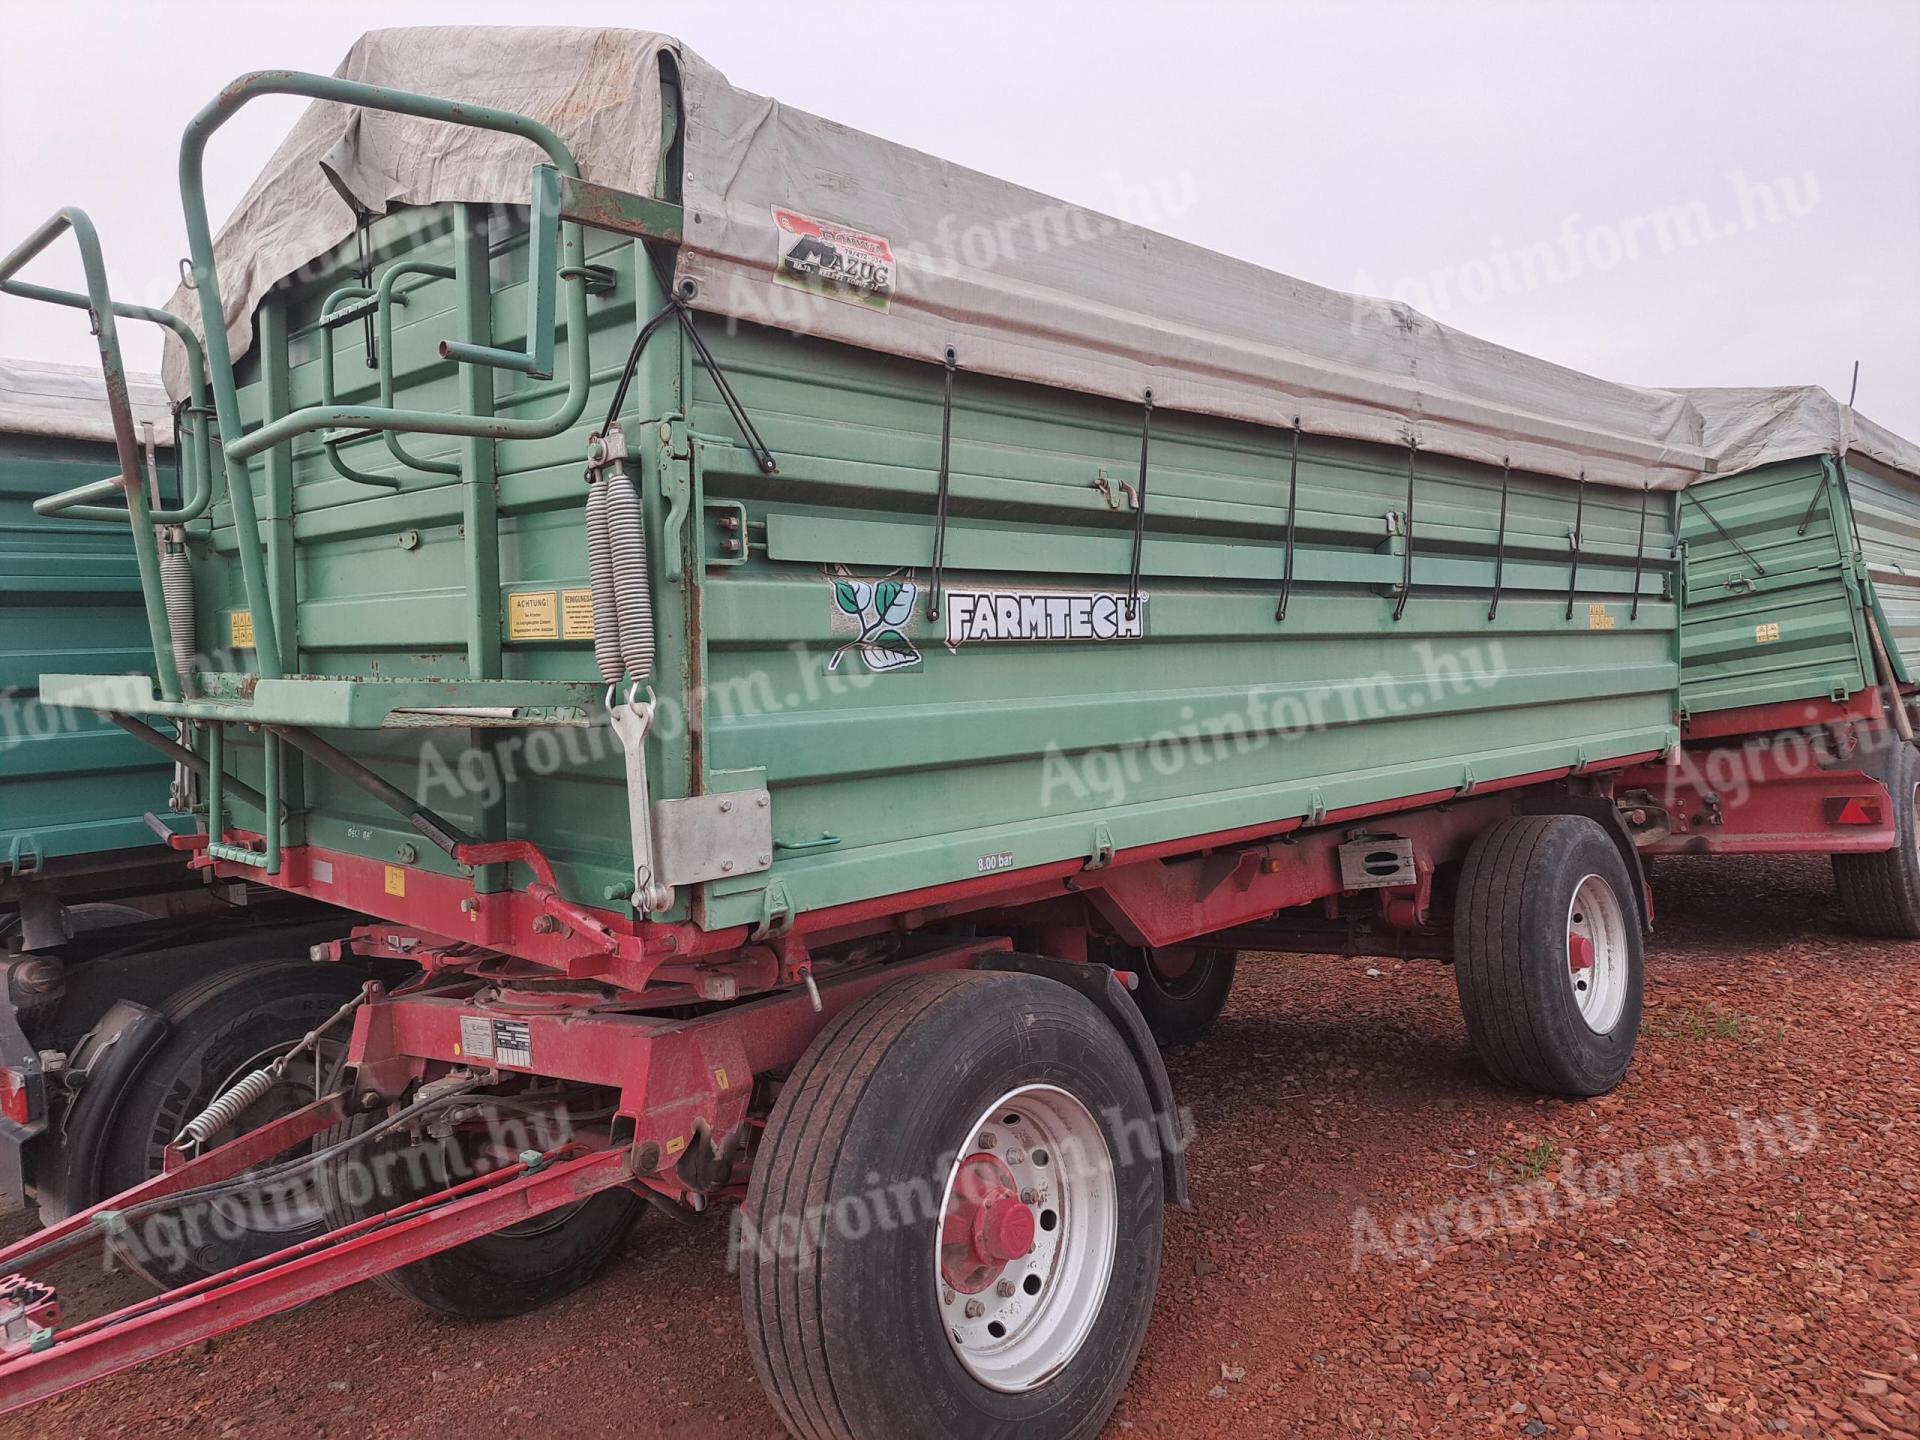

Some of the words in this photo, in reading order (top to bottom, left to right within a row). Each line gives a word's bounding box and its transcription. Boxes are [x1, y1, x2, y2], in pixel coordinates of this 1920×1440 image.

[785, 234, 890, 287] MAZUG
[517, 598, 549, 608] ACHTUNG!
[945, 590, 1144, 642] FARMTECH
[977, 855, 996, 871] 8.00
[998, 853, 1013, 868] bar
